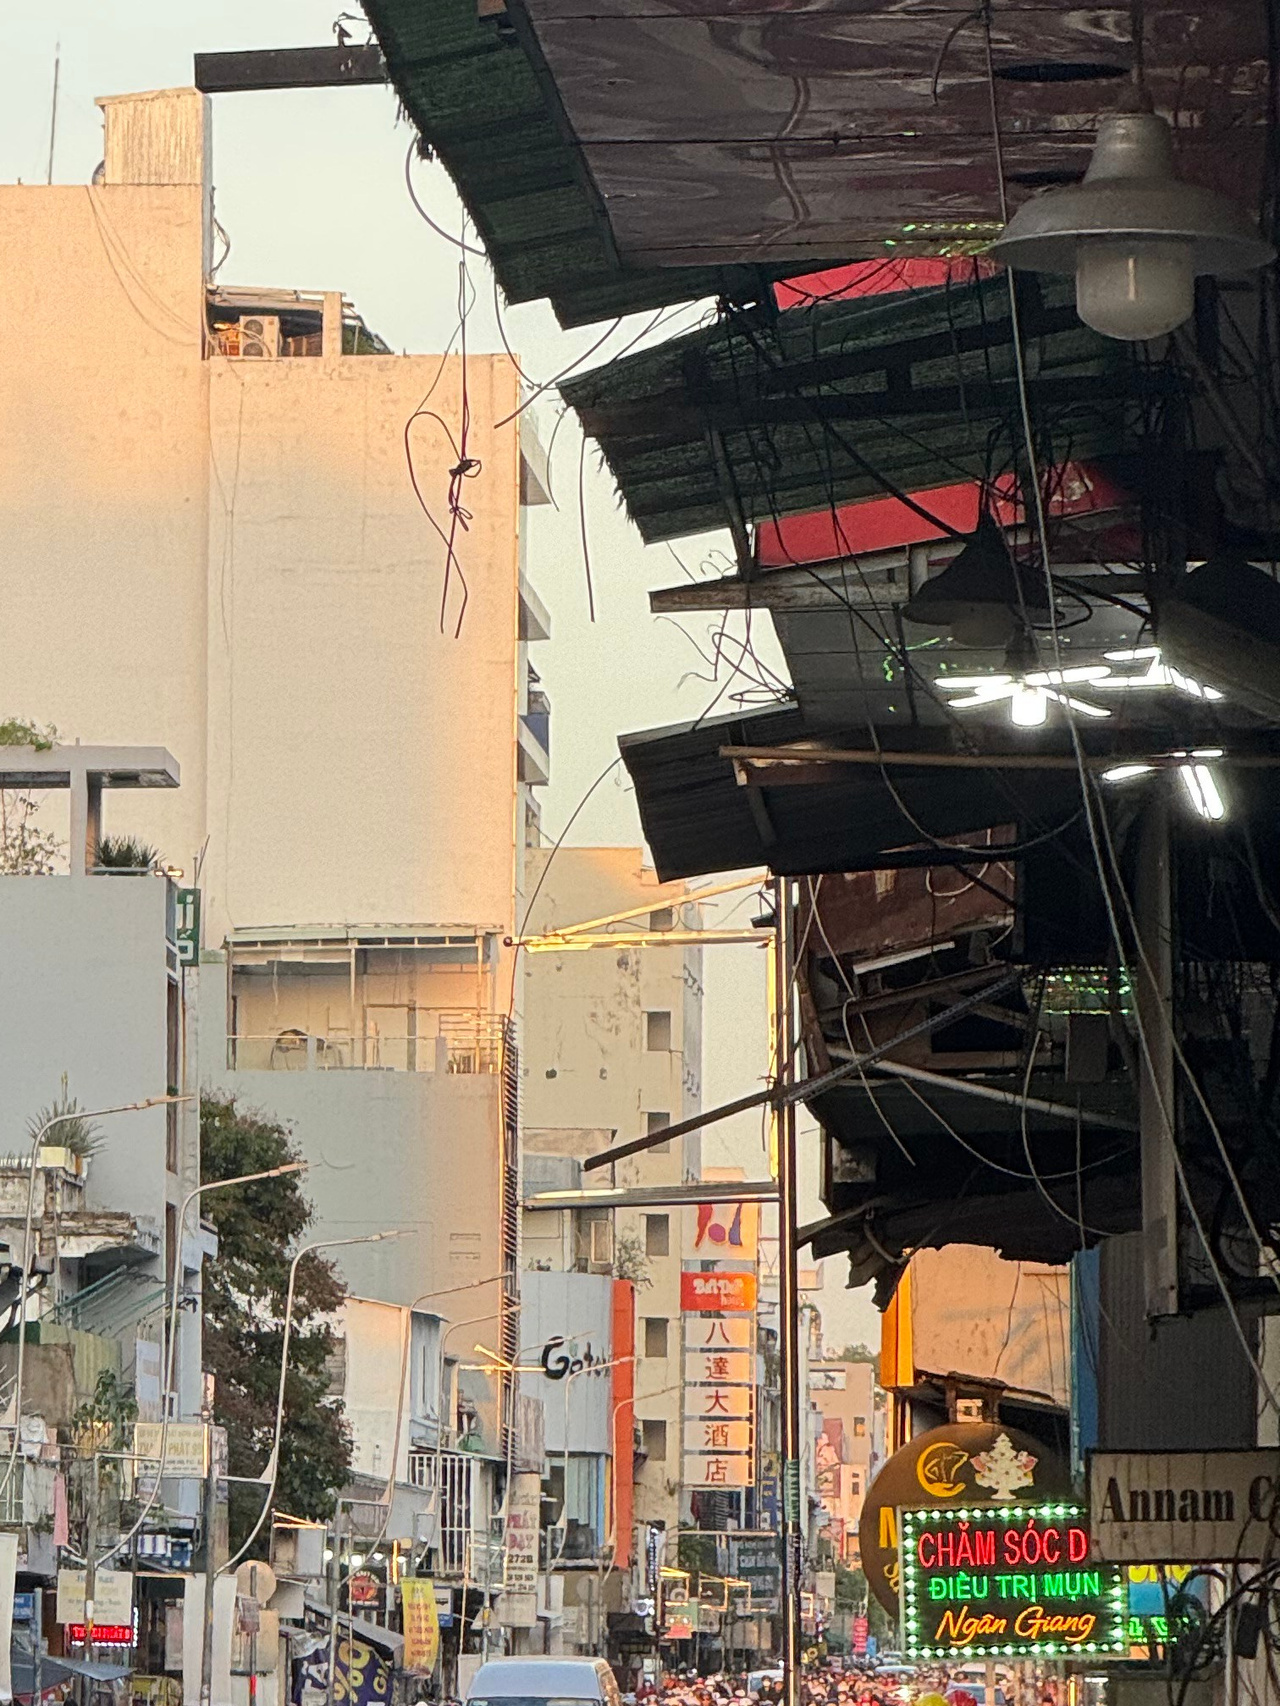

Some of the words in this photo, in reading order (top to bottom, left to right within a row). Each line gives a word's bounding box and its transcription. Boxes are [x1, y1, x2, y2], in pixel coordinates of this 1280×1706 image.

[704, 1321, 730, 1484] 八達大酒店
[1100, 1476, 1236, 1524] Annam
[1249, 1475, 1274, 1522] C
[918, 1519, 996, 1567] CHĂM
[1004, 1519, 1061, 1565] SÓC
[1069, 1529, 1087, 1562] D
[928, 1571, 989, 1600] ĐIỀU
[995, 1573, 1037, 1603] TRỊ
[1044, 1571, 1101, 1602] MỤN
[935, 1605, 1007, 1645] Ngân
[1014, 1606, 1097, 1642] Giang
